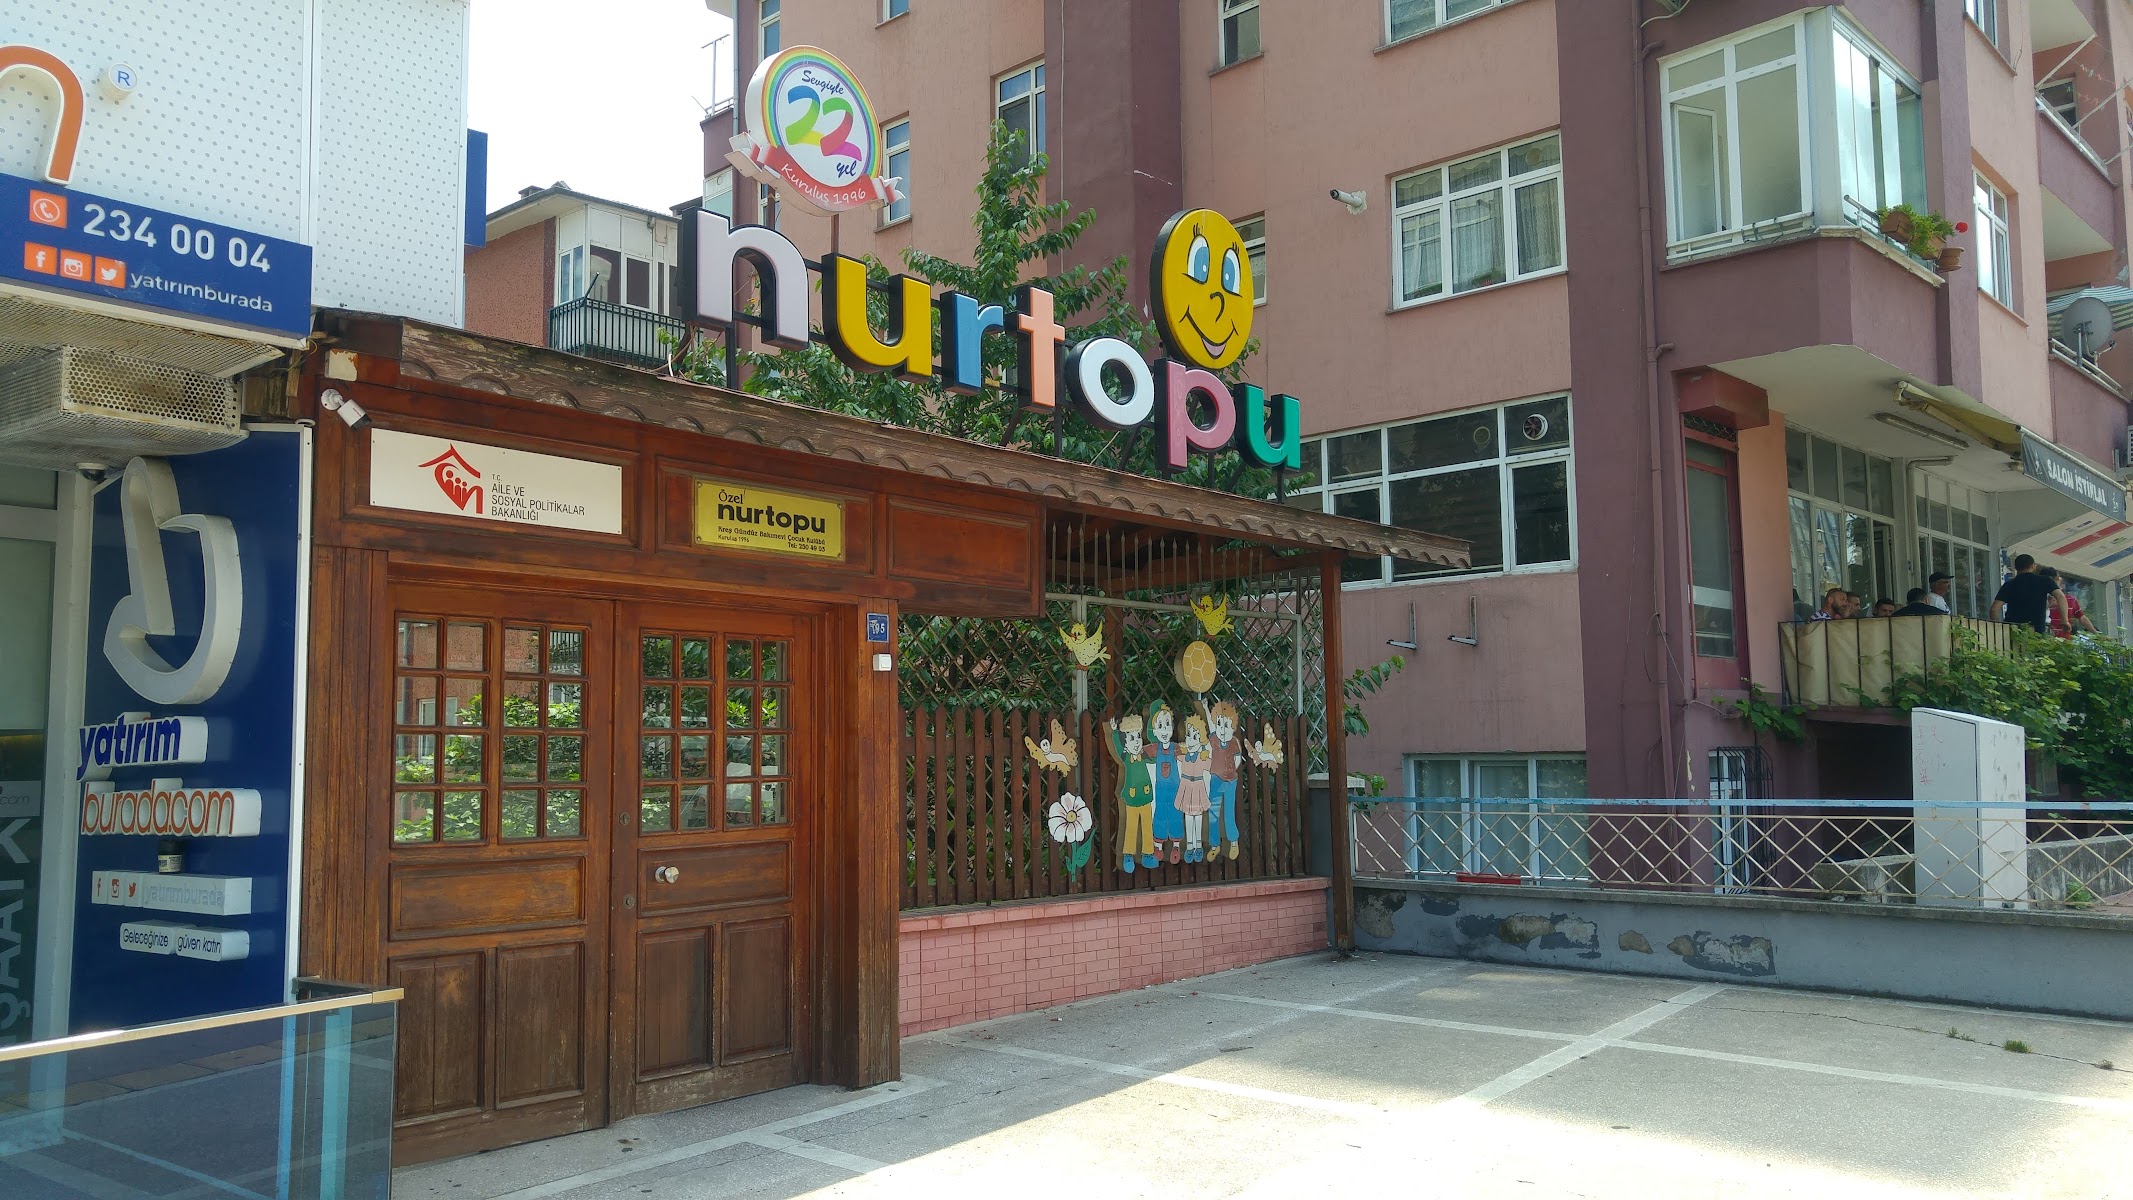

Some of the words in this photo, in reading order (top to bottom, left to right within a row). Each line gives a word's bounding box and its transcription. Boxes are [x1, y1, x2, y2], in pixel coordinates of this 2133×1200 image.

[801, 69, 845, 95] Sevgiyle
[785, 85, 862, 161] 22
[781, 163, 829, 204] Kuruluş
[833, 187, 866, 205] 1996
[83, 203, 157, 248] 234
[170, 223, 215, 261] 00
[228, 237, 271, 273] 04
[130, 271, 273, 313] yatırımburada
[678, 206, 1300, 474] nurtopu
[491, 481, 511, 495] AİLE
[513, 486, 525, 497] VE
[2047, 459, 2075, 490] SALON
[491, 495, 527, 508] SOSYAL
[529, 499, 585, 516] POLİTİKALAR
[718, 489, 743, 504] Özel
[491, 507, 539, 521] BAKANLIĞI
[718, 503, 826, 534] nurtopu
[76, 715, 181, 780] yatırım
[177, 935, 201, 952] güven
